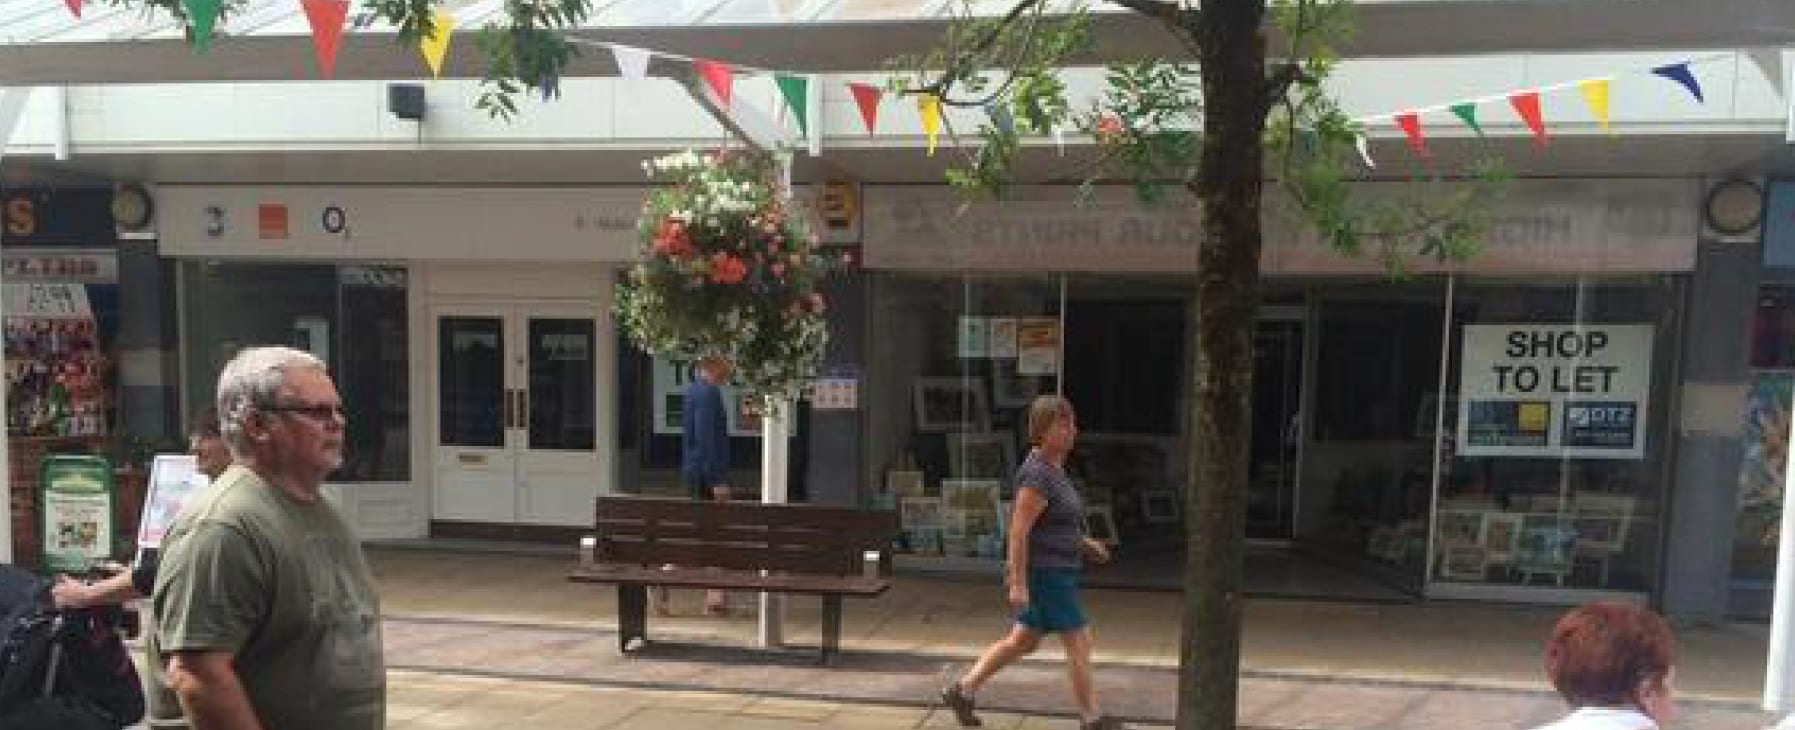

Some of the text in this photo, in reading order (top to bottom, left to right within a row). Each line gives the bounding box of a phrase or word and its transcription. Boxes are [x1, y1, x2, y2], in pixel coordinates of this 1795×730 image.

[1505, 331, 1609, 358] SHOP
[1493, 366, 1620, 393] TO LET
